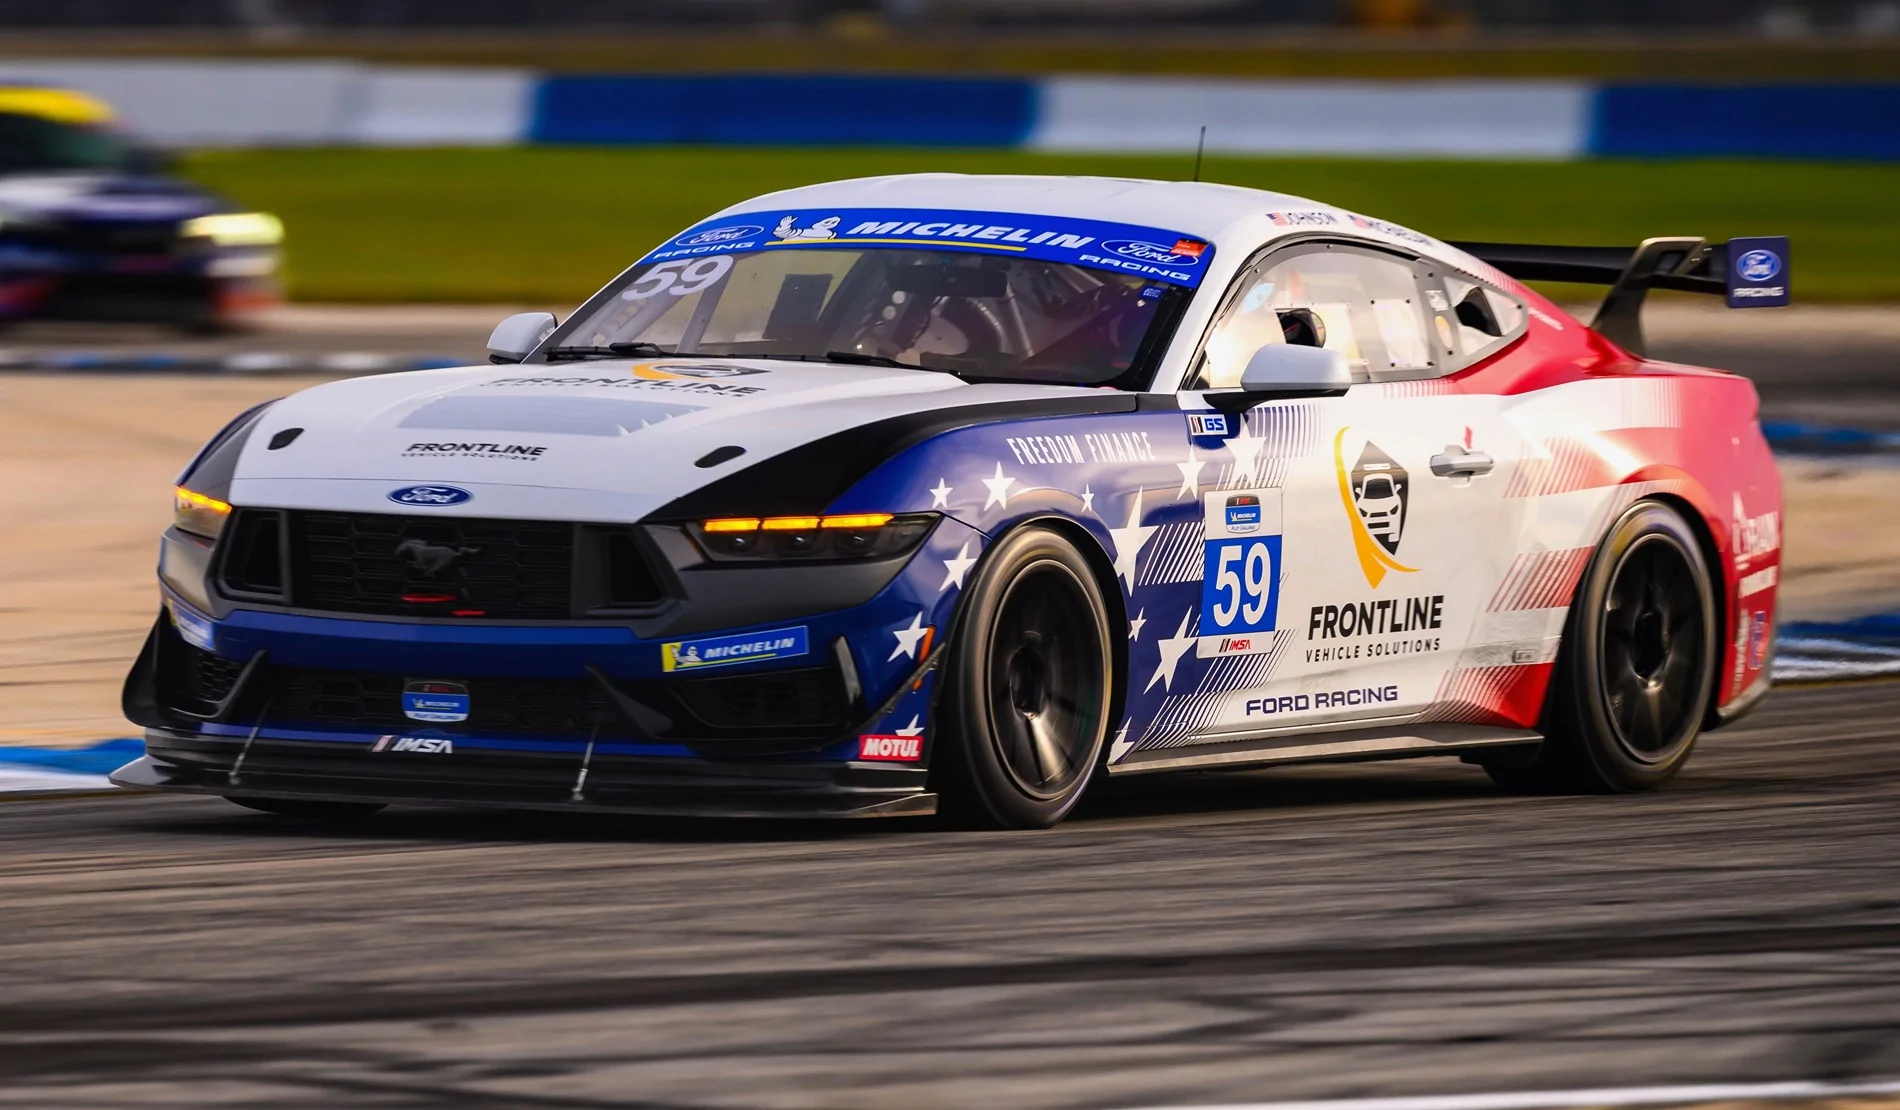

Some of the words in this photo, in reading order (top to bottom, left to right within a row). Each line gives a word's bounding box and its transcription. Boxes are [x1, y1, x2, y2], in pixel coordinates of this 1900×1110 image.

[689, 228, 749, 245] Ford
[846, 221, 1096, 249] MICHELIN
[653, 241, 756, 260] RACING
[1117, 242, 1179, 263] Ford
[621, 254, 734, 301] 59
[1078, 254, 1191, 281] RACING
[1204, 417, 1226, 431] GS
[406, 442, 548, 457] FRONTLINE
[1006, 434, 1085, 466] FREEDOM
[1086, 431, 1156, 463] FINANCE
[400, 486, 460, 504] Ford
[1212, 541, 1272, 628] 59
[1307, 594, 1445, 641] FRONTLINE
[703, 637, 796, 659] MICHELIN
[1228, 639, 1252, 652] IMSA
[1305, 644, 1360, 663] VEHICLE
[1366, 637, 1442, 658] SOLUTIONS
[1245, 694, 1310, 717] FORD
[1314, 685, 1399, 710] RACING
[390, 737, 453, 754] IMSA
[861, 737, 920, 758] MOTUL
